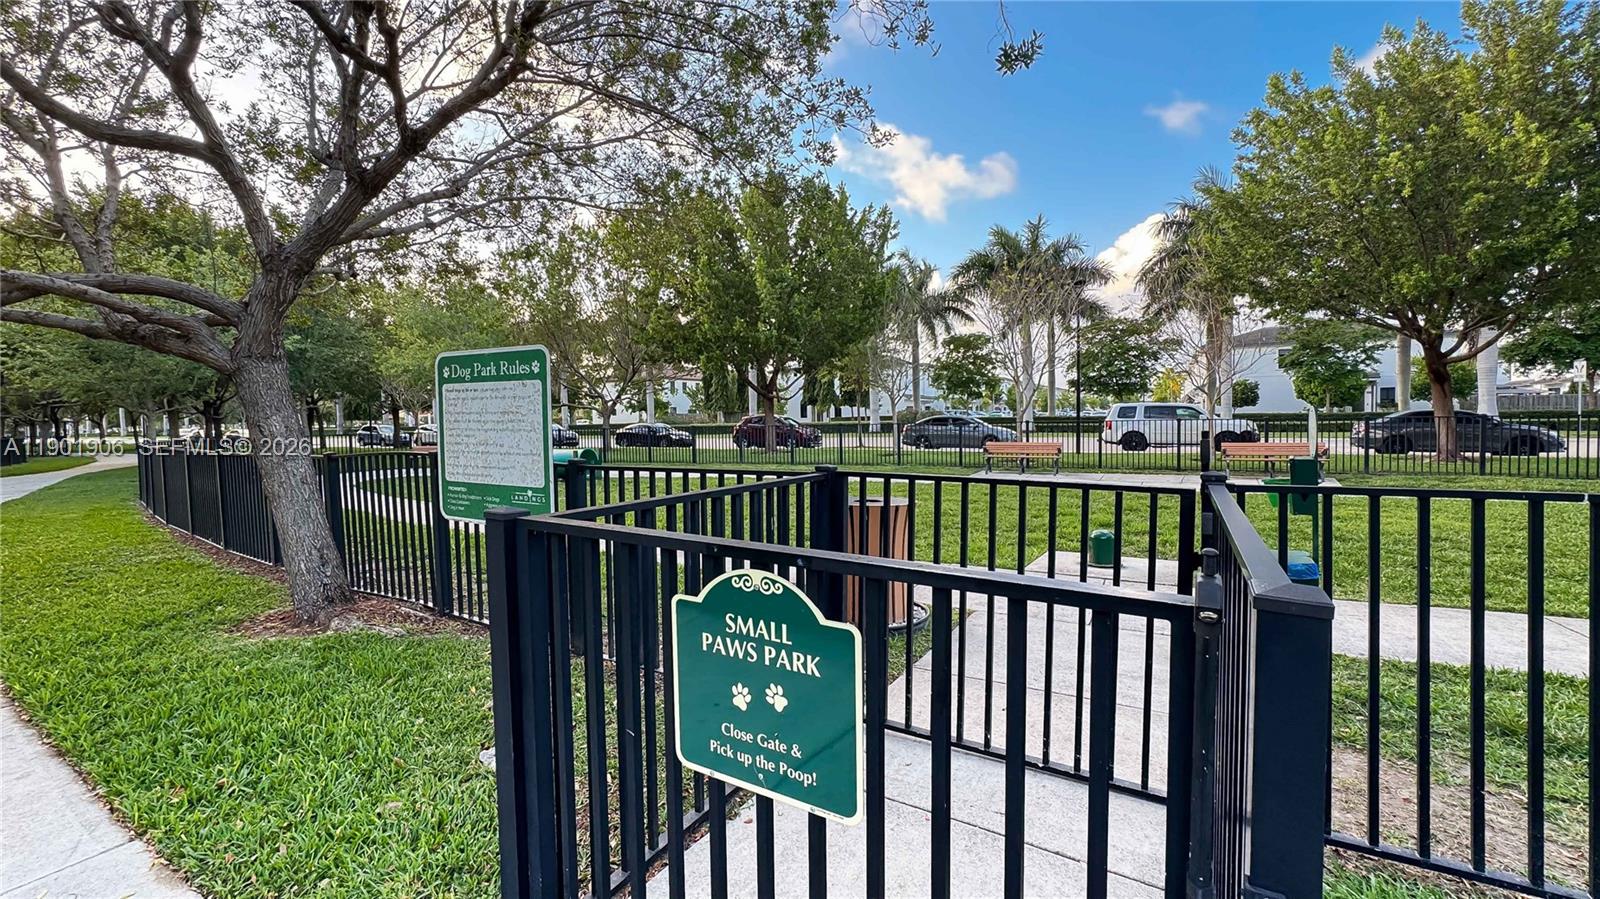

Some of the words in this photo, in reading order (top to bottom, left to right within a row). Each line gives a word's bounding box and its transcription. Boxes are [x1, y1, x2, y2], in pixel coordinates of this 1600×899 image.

[451, 364, 472, 381] Dog
[473, 361, 497, 377] Park
[500, 360, 530, 375] Rules
[725, 613, 793, 645] SMALL
[702, 632, 758, 663] PAWS
[764, 645, 821, 678] PARK
[721, 722, 753, 743] Close
[757, 733, 787, 754] Gate
[791, 743, 802, 759] &
[710, 739, 734, 759] Pick
[737, 751, 752, 767] up
[756, 754, 775, 773] the
[779, 761, 817, 787] Poop!
